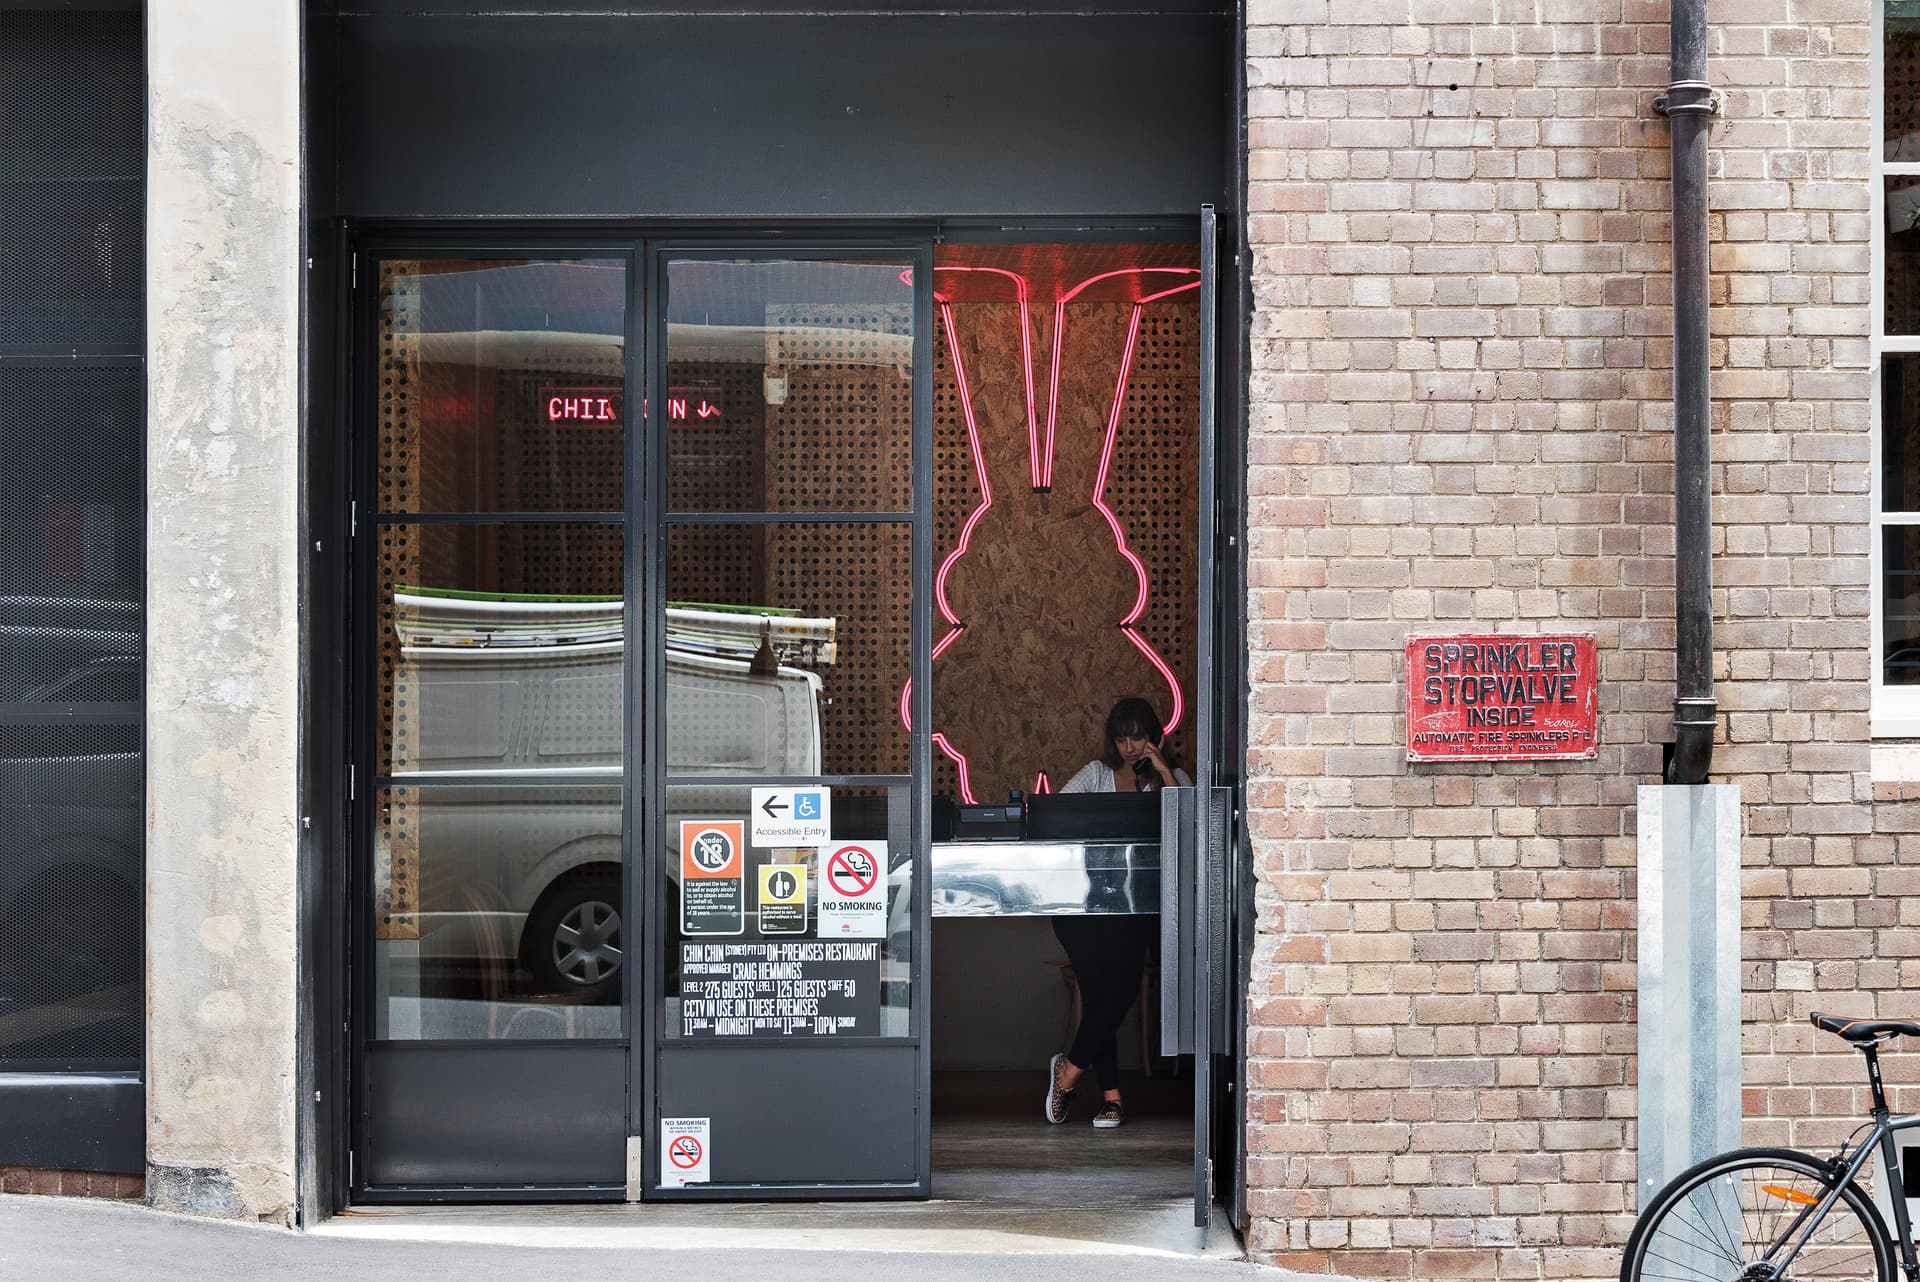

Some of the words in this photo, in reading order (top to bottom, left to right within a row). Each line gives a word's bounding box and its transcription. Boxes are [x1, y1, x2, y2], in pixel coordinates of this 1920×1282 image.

[1425, 642, 1577, 673] SPRINKLER
[1425, 674, 1578, 705] STOPVALVE
[1467, 706, 1537, 727] INSIDE
[1413, 731, 1475, 744] AUTOMATIC
[1479, 731, 1503, 743] FIRE
[1507, 731, 1569, 742] SPRINKLERS
[756, 827, 802, 836] Accessible
[804, 827, 826, 837] Entry
[822, 902, 837, 911] NO
[838, 902, 882, 911] SMOKING
[683, 944, 703, 962] CHIN
[704, 944, 724, 962] CHIN
[747, 944, 757, 956] PTY
[757, 944, 766, 955] LTD
[825, 943, 878, 961] RESTAURANT
[683, 963, 708, 974] APPROVED
[708, 963, 732, 974] MANAGER
[733, 962, 757, 980] CRAIG
[758, 962, 802, 980] HEMMINGS
[683, 981, 699, 993] LEVEL
[699, 981, 704, 993] 2
[705, 981, 720, 998] 275
[722, 981, 754, 998] GUESTS
[755, 981, 771, 992] LEVEL
[771, 981, 776, 992] 1
[776, 980, 792, 998] 125
[793, 980, 826, 998] GUESTS
[827, 980, 843, 991] STAFF
[844, 980, 856, 997] 50
[683, 999, 705, 1017] CCTV
[706, 999, 715, 1017] IN
[716, 999, 733, 1017] USE
[734, 999, 747, 1017] ON
[747, 999, 775, 1017] THESE
[776, 998, 819, 1017] PREMISES
[715, 1017, 755, 1035] MIDNIGHT
[773, 1017, 782, 1028] SAT
[837, 1016, 856, 1027] SUNDAY
